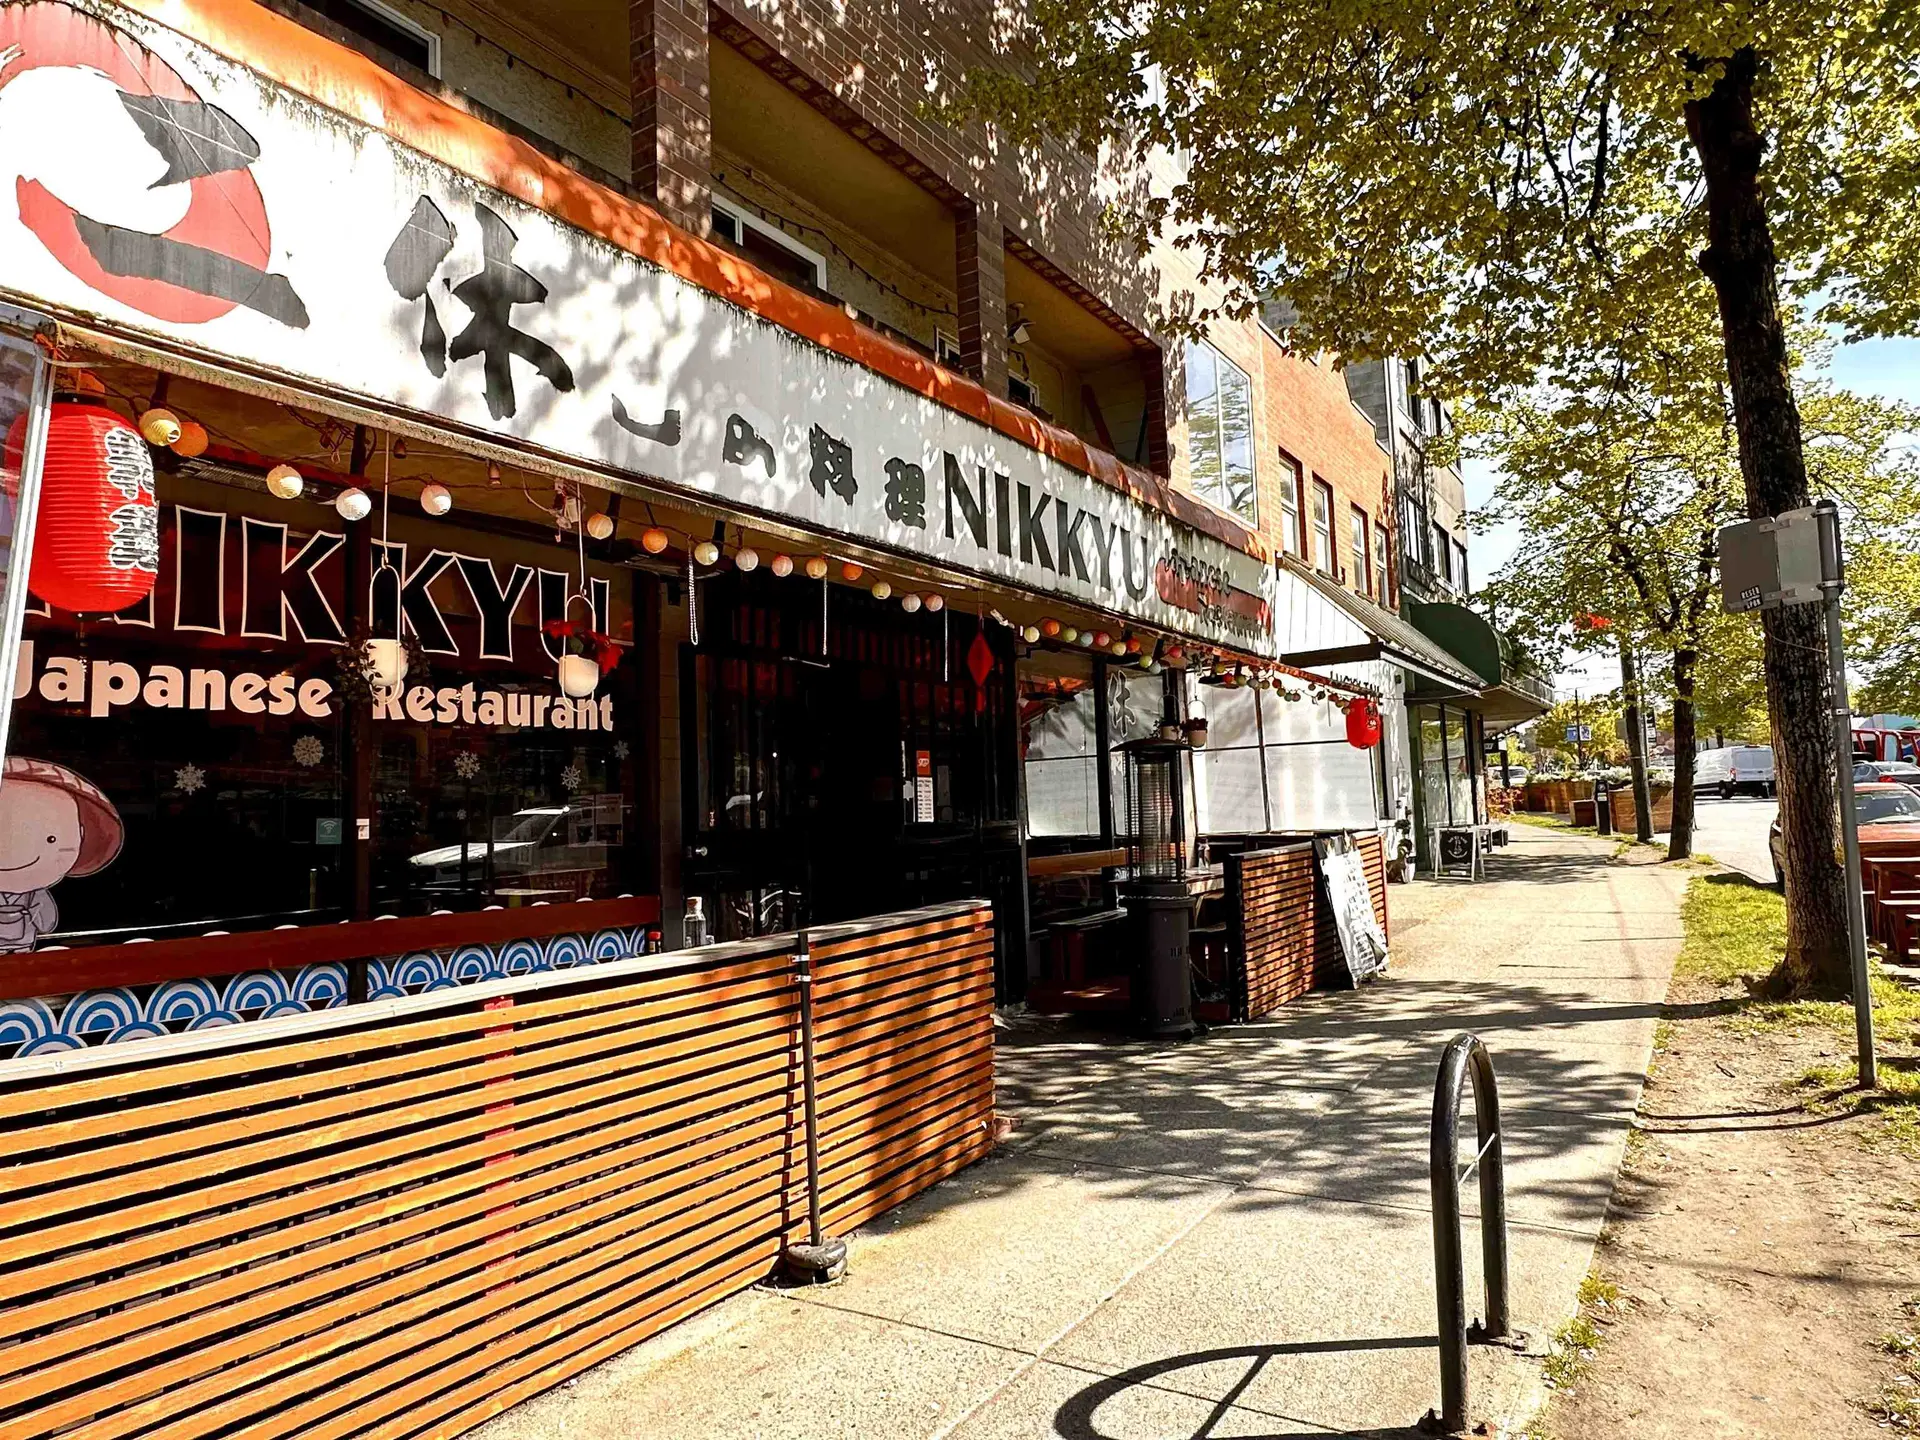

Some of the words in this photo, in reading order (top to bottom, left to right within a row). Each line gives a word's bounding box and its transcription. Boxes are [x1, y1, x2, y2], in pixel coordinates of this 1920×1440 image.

[24, 503, 611, 663] IKKYU
[943, 450, 1148, 601] NIKKYU
[13, 640, 333, 718] Japanese
[371, 680, 614, 732] Restaurant
